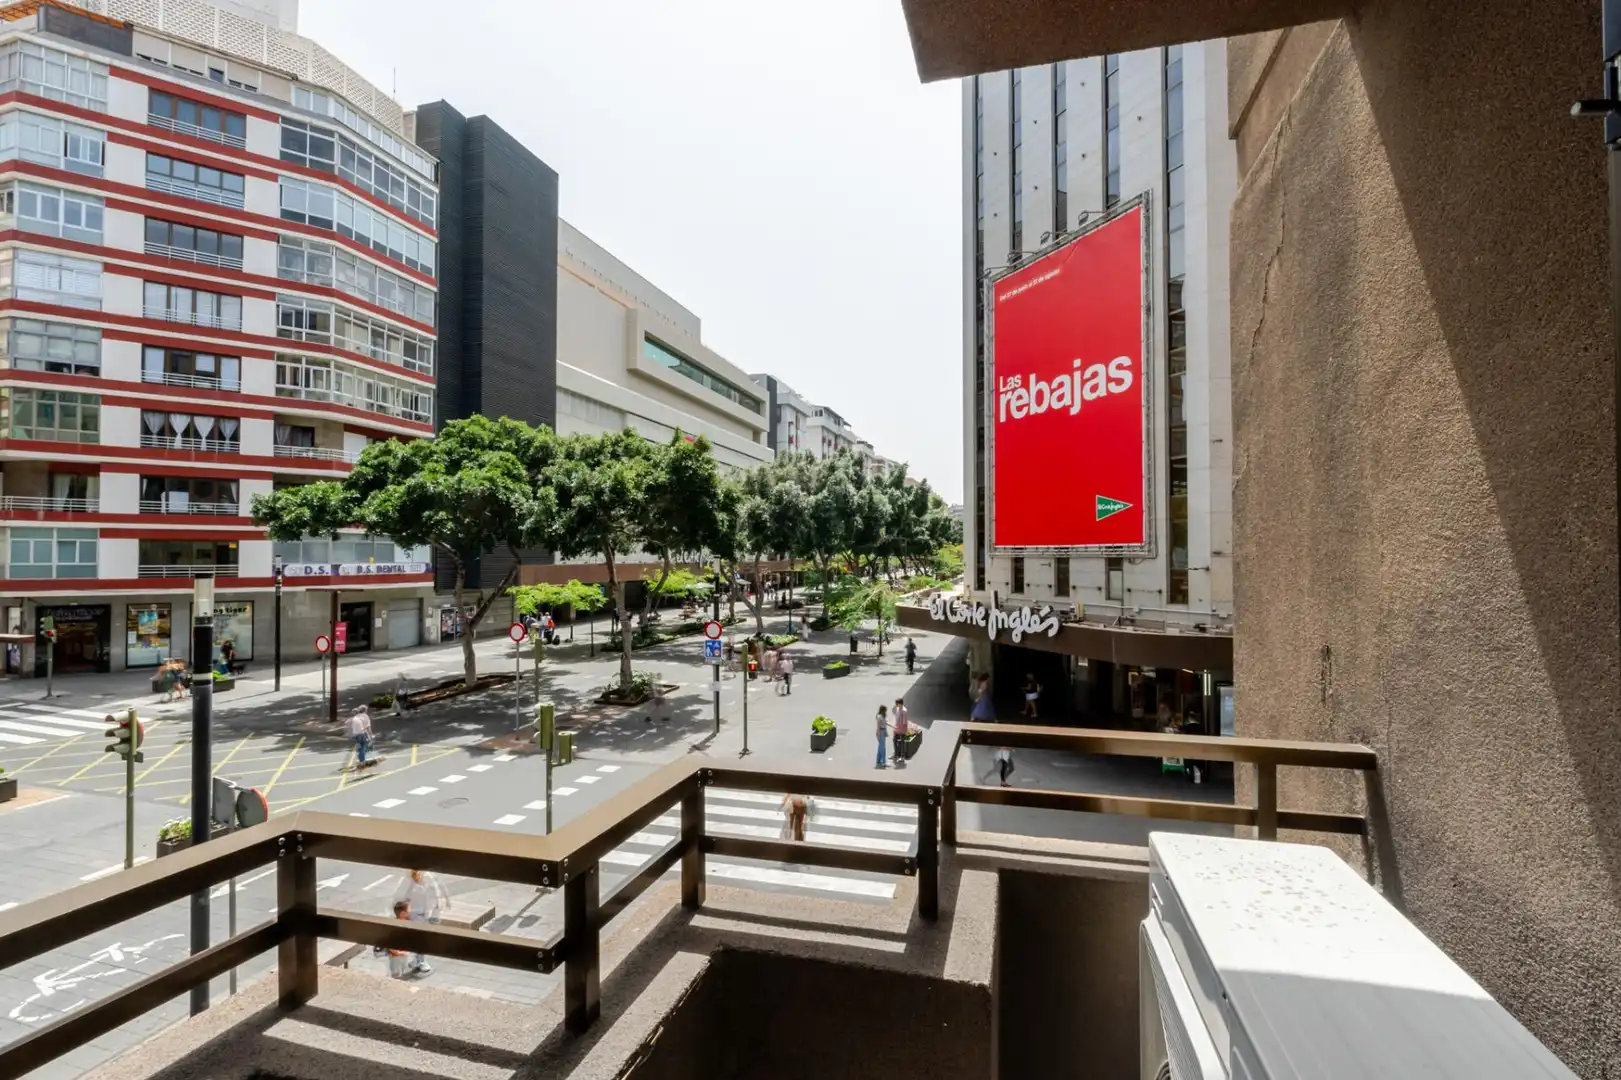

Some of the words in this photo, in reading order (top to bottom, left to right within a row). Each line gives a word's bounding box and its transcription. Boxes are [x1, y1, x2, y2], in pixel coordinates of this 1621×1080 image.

[999, 374, 1022, 393] Las
[999, 355, 1133, 423] rebajas
[376, 565, 406, 573] DENTAL
[946, 595, 986, 627] Corte
[987, 589, 1060, 643] Inglés
